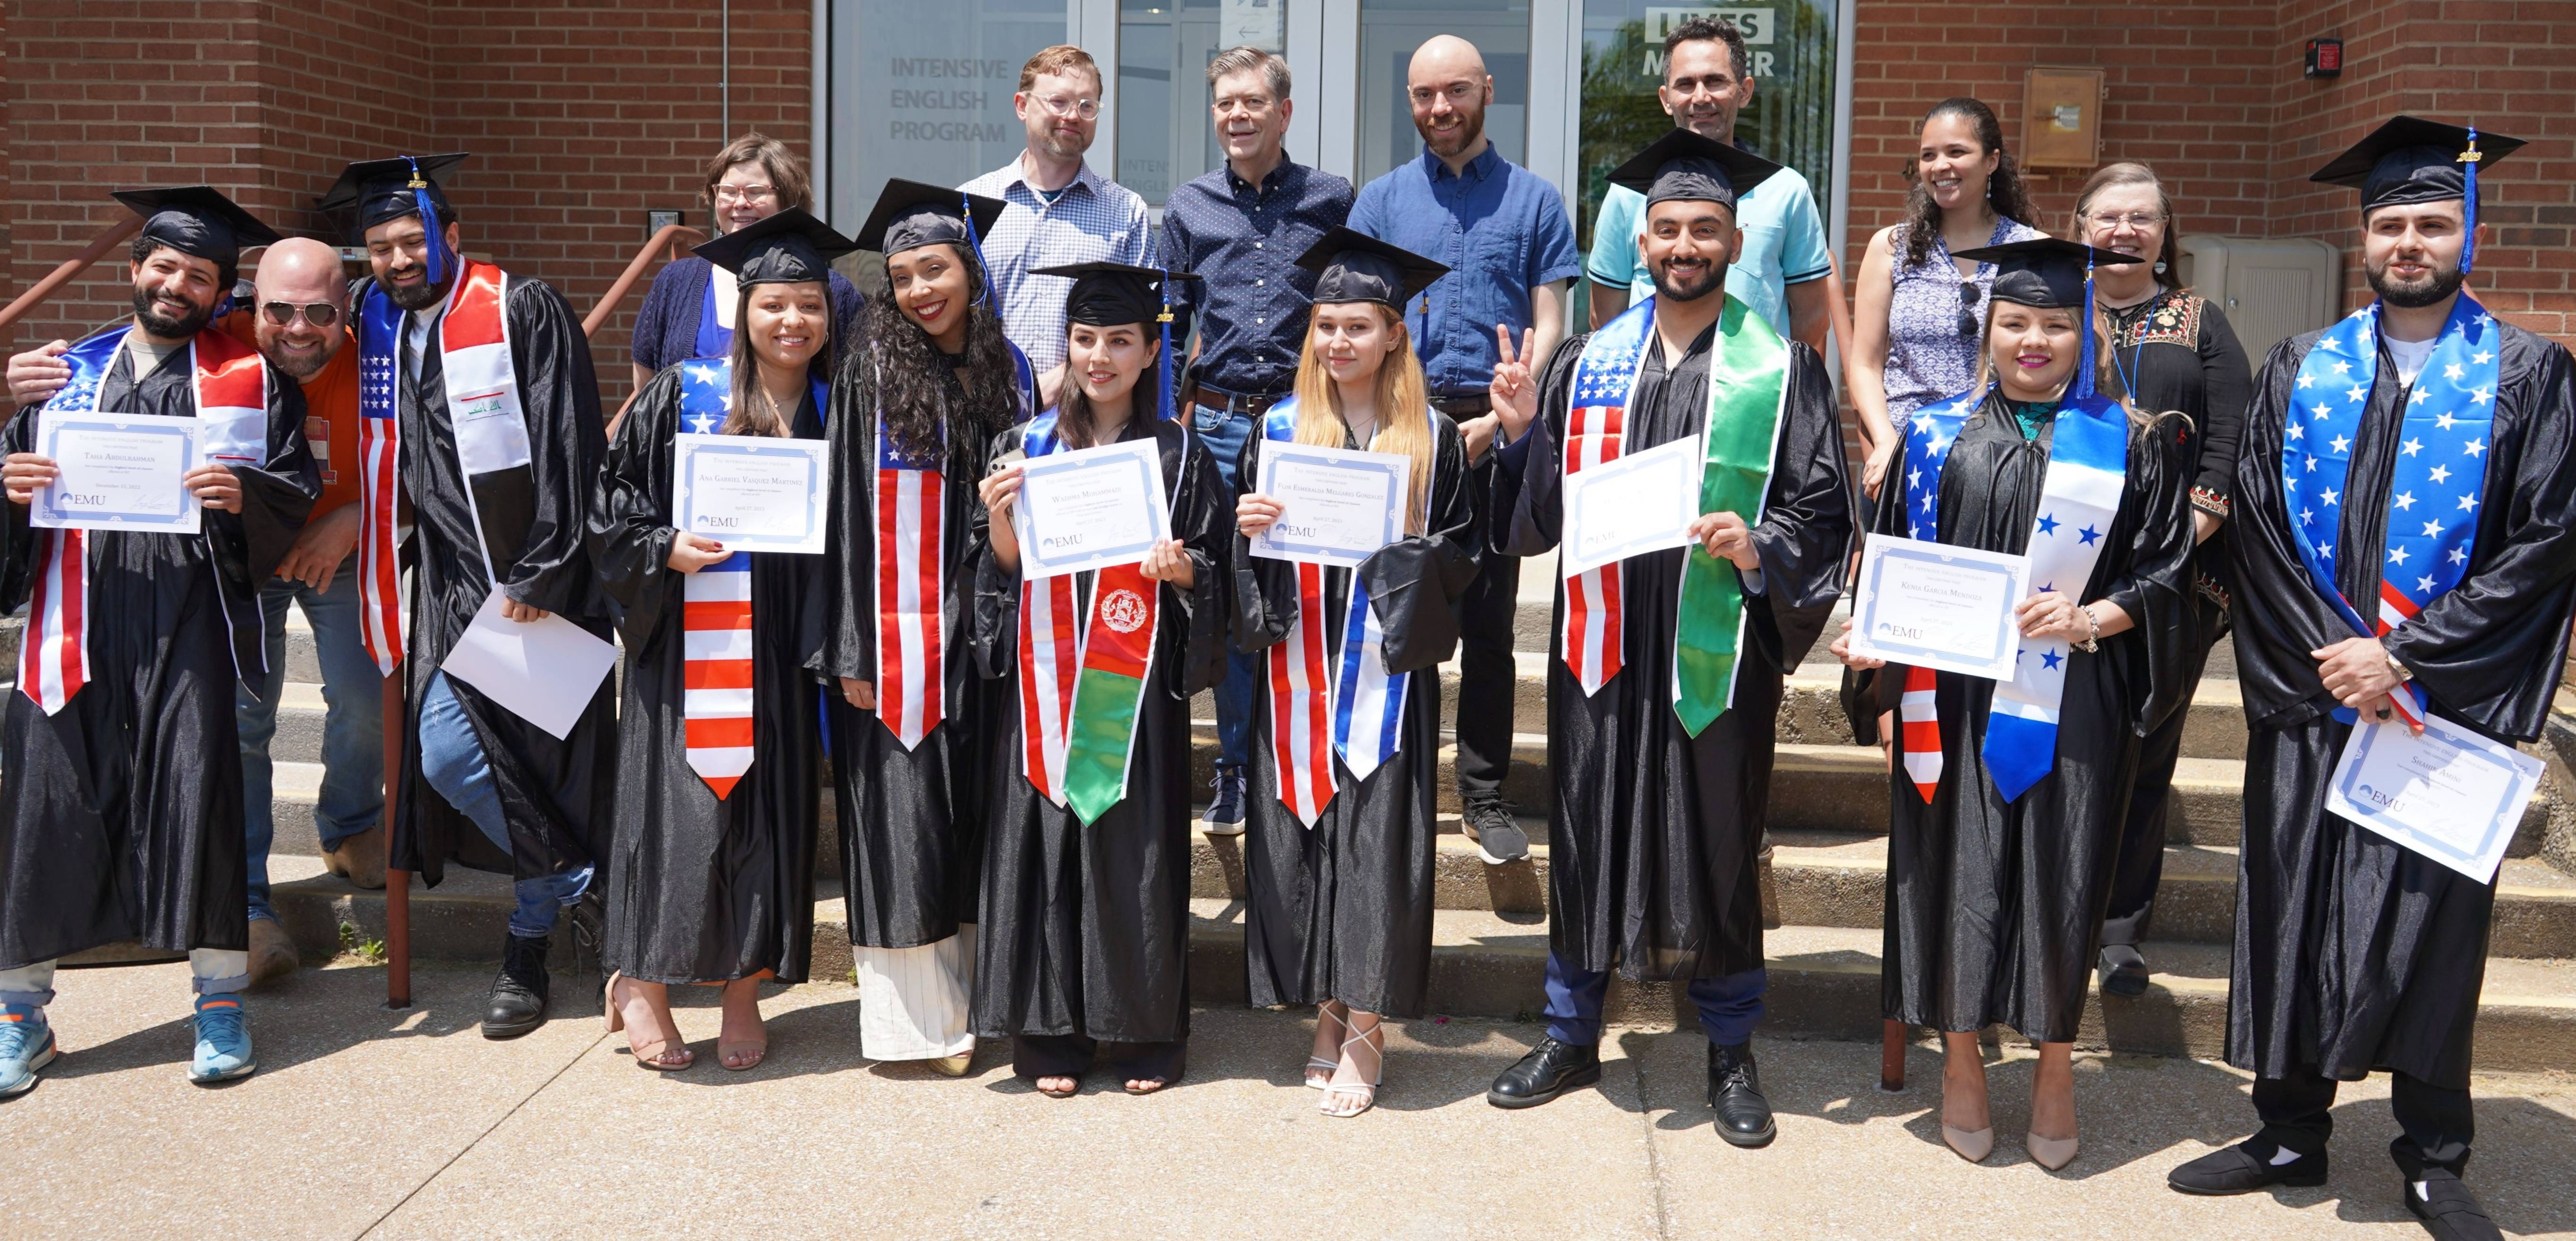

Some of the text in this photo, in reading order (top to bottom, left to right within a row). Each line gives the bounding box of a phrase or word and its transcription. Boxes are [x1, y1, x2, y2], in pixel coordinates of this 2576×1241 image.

[892, 58, 1008, 79] INTENSIVE
[1642, 50, 1774, 77] MER
[891, 89, 988, 110] ENGLISH
[890, 121, 1006, 142] PROGRAM
[105, 453, 155, 462] ABDULRAHMAN
[715, 475, 741, 483] GABRIEL
[743, 476, 769, 484] VASQUEZ
[74, 494, 105, 505] EMU
[1052, 487, 1121, 503] WAZHMA MOHAMMADI
[1293, 484, 1324, 493] ESMERALDA
[1326, 488, 1354, 497] MELGARES
[1355, 491, 1384, 500] GONZALEZ
[710, 517, 738, 527] EMU
[1288, 526, 1316, 537] EMU
[1055, 534, 1082, 547] EMU
[1901, 581, 1982, 600] KENIA GARCIA MENDOZA
[1892, 625, 1922, 639] EMU
[2402, 729, 2414, 739] THE
[2414, 736, 2441, 752] INTENSIVE
[2411, 756, 2462, 784] SHAHIN AMINI
[2372, 790, 2406, 812] EMU
